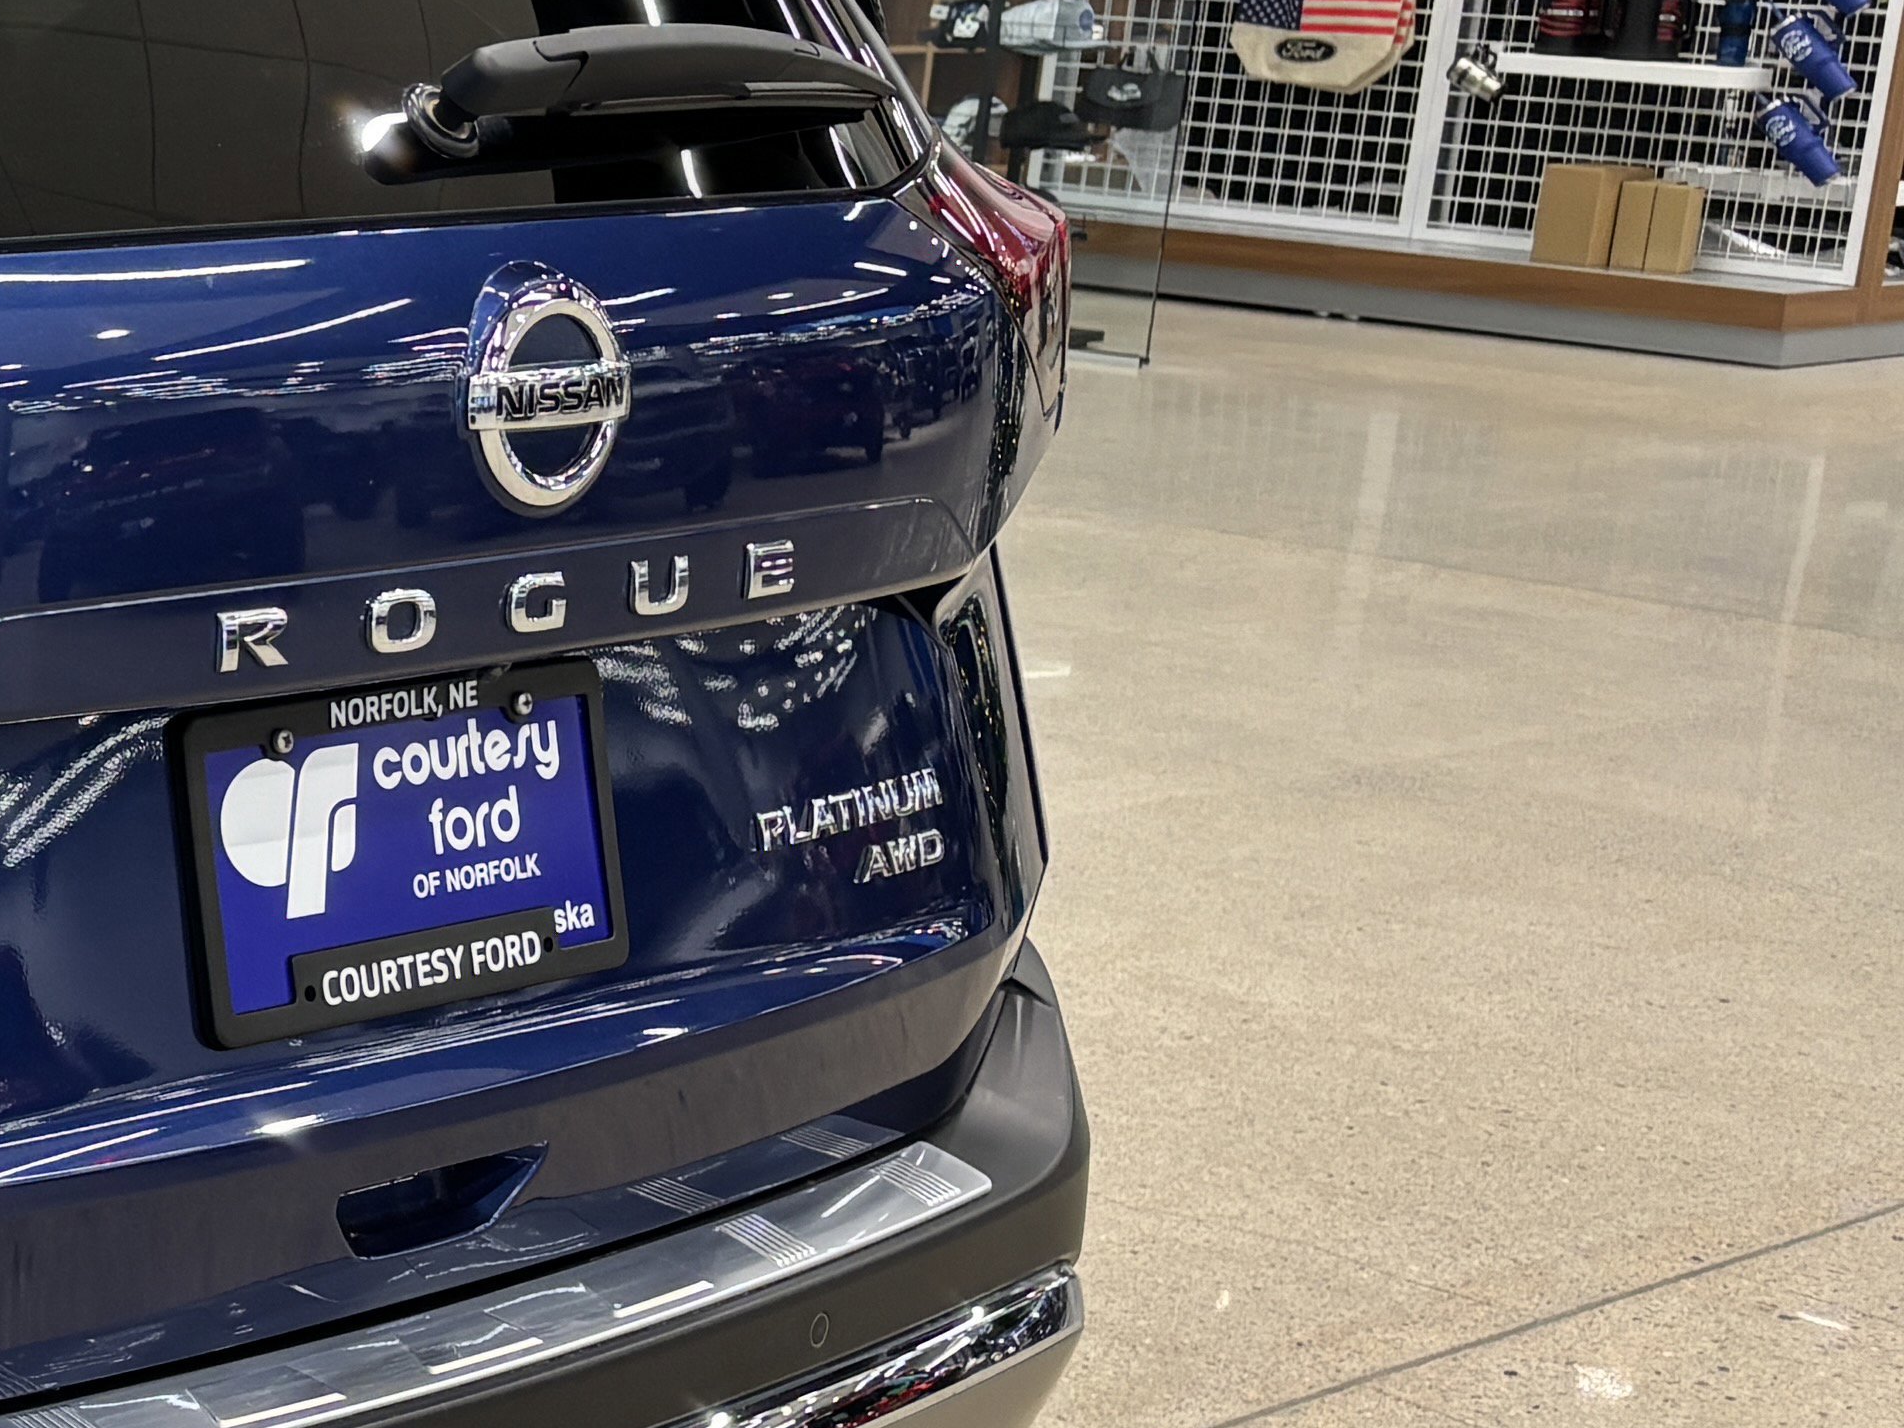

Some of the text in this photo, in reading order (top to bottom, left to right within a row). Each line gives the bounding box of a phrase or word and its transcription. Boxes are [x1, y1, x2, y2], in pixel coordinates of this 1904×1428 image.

[495, 376, 625, 419] NISSAN
[215, 538, 796, 673] ROGUE
[330, 680, 479, 728] NORFOLK, NE
[373, 718, 560, 789] courtesy
[428, 785, 521, 855] ford
[752, 767, 944, 852] PLATINUM
[413, 852, 542, 899] OF NORFOLK
[853, 828, 945, 884] AWD
[553, 900, 596, 934] ska
[321, 930, 542, 1007] COURTESY FORD
